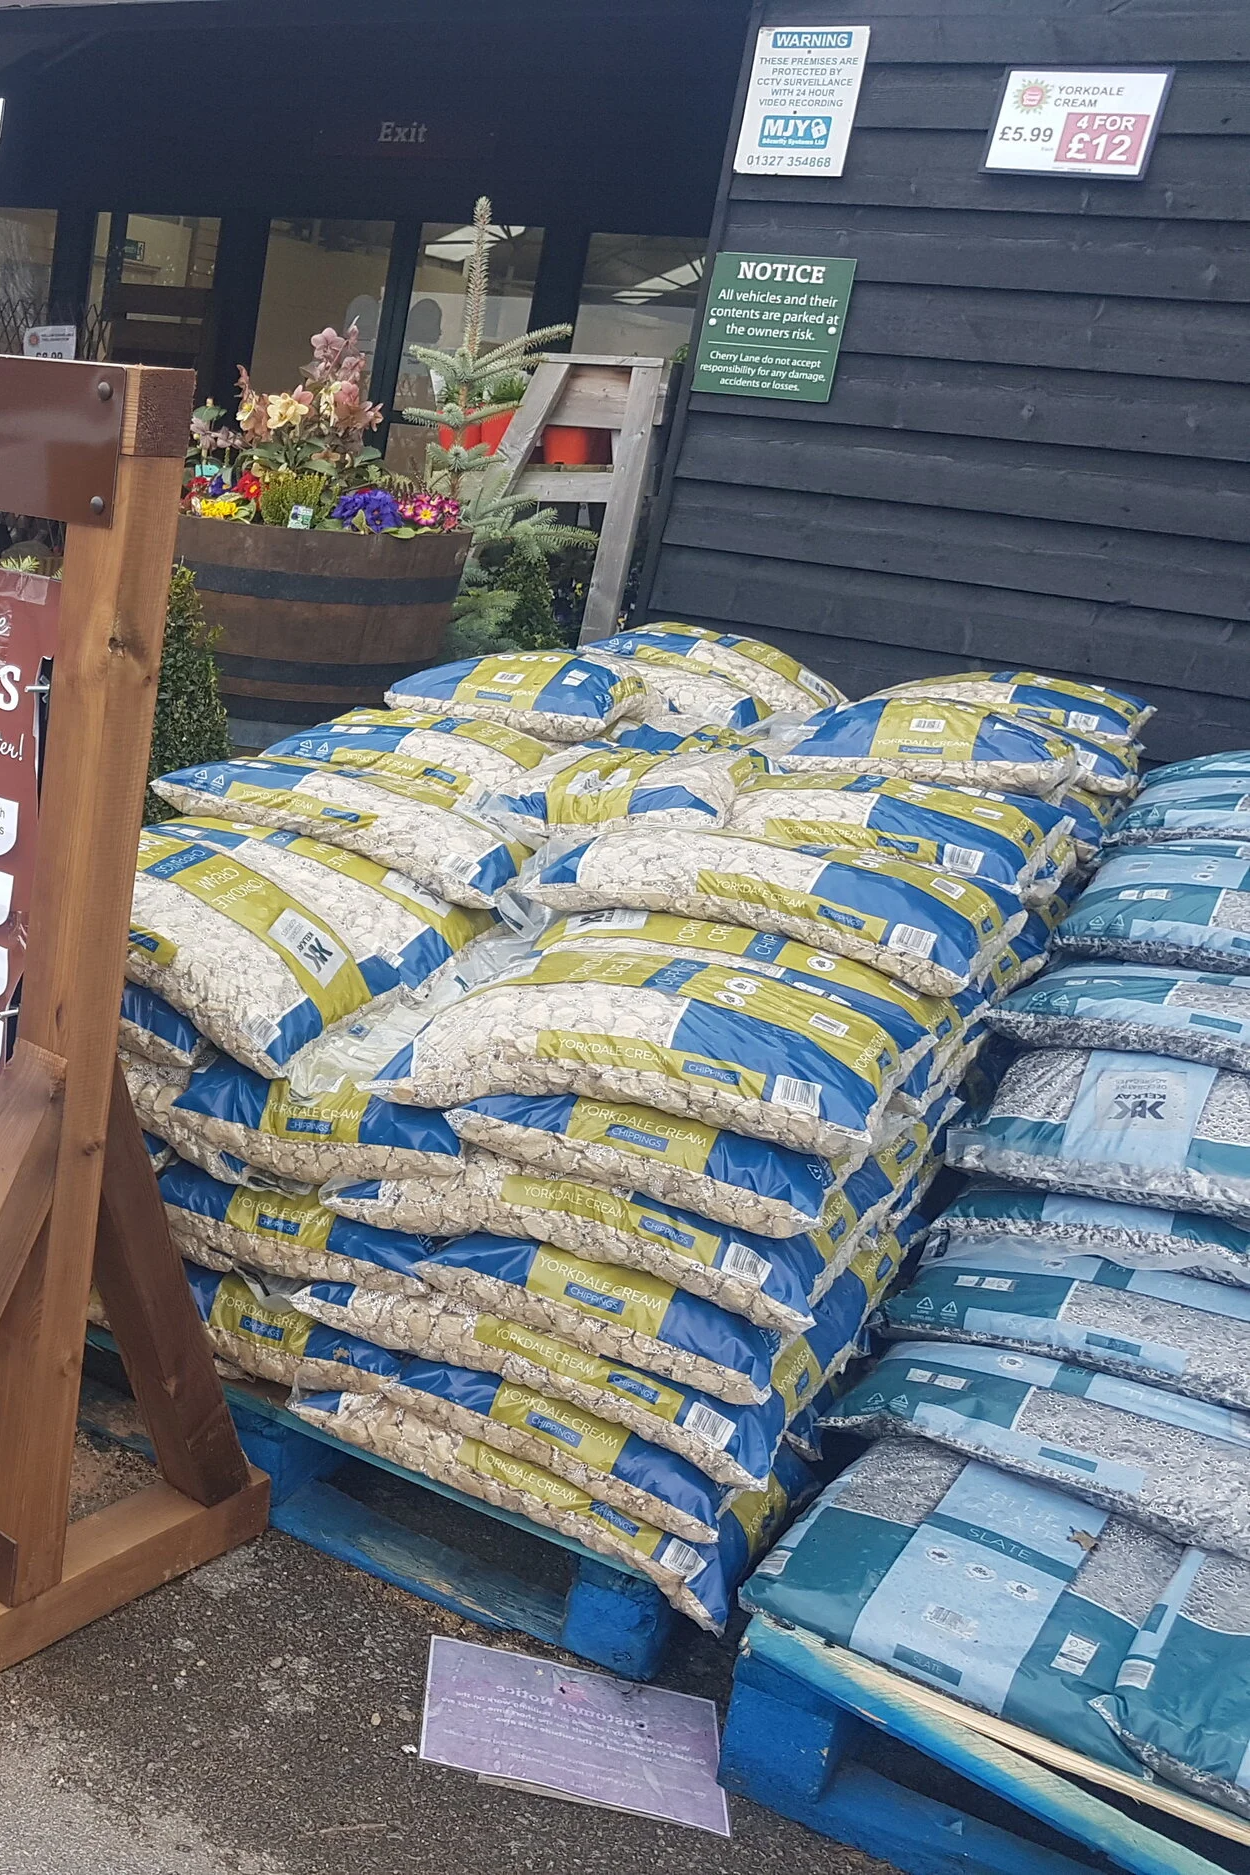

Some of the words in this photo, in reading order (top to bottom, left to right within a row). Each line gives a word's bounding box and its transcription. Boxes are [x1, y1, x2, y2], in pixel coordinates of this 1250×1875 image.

[776, 34, 848, 46] WARNING
[772, 68, 827, 76] PROTECTED
[830, 68, 842, 76] BY
[1058, 86, 1125, 96] YORKDALE
[1054, 98, 1098, 108] CREAM
[378, 121, 428, 143] Exit
[764, 119, 811, 136] MJY
[1076, 115, 1089, 130] 4
[1092, 116, 1136, 131] FOR
[999, 126, 1053, 142] £5.99
[1066, 133, 1132, 161] £12
[747, 155, 784, 166] 01327
[787, 157, 831, 167] 354868
[737, 261, 826, 284] NOTICE
[718, 289, 733, 300] All
[736, 291, 782, 303] vehicles
[784, 294, 807, 305] and
[809, 295, 838, 307] their
[710, 307, 760, 320] contents
[762, 311, 781, 320] are
[782, 312, 824, 324] parked
[826, 315, 839, 325] at
[726, 323, 745, 335] the
[747, 327, 790, 338] owners
[792, 329, 815, 341] risk.
[710, 350, 738, 362] Cherry
[739, 353, 760, 363] Lane
[762, 355, 774, 364] do
[775, 356, 790, 365] not
[791, 359, 821, 369] accept
[700, 363, 757, 376] responsibility
[757, 367, 770, 376] for
[771, 369, 787, 379] any
[720, 377, 759, 388] accidents
[772, 381, 800, 392] losses.
[195, 867, 240, 891] CREAM
[212, 877, 269, 910] YORKDALE
[715, 879, 770, 897] YORKDALE
[770, 892, 806, 909] CREAM
[821, 908, 863, 929] CHIPPINGS
[558, 1038, 622, 1057] YORKDALE
[624, 1047, 668, 1065] CREAM
[688, 1062, 737, 1082] CHIPPINGS
[1114, 1092, 1166, 1100] KELKAY
[579, 1102, 653, 1132] YORKDALE
[655, 1124, 708, 1148] CREAM
[611, 1127, 663, 1148] CHIPPINGS
[523, 1185, 583, 1205] YORKDALE
[585, 1197, 626, 1219] CREAM
[644, 1219, 690, 1245] CHIPPINGS
[539, 1255, 615, 1294] YORKDALE
[612, 1286, 663, 1312] CREAM
[570, 1286, 620, 1310] CHIPPINGS
[495, 1327, 553, 1361] YORKDALE
[553, 1351, 596, 1376] CREAM
[613, 1375, 656, 1400] CHIPPINGS
[503, 1386, 569, 1425] YORKDALE
[571, 1418, 619, 1449] CREAM
[531, 1416, 578, 1444] CHIPPINGS
[479, 1448, 536, 1485] YORKDALE
[537, 1478, 578, 1503] CREAM
[969, 1526, 1033, 1561] SLATE
[912, 1655, 943, 1675] SLATE
